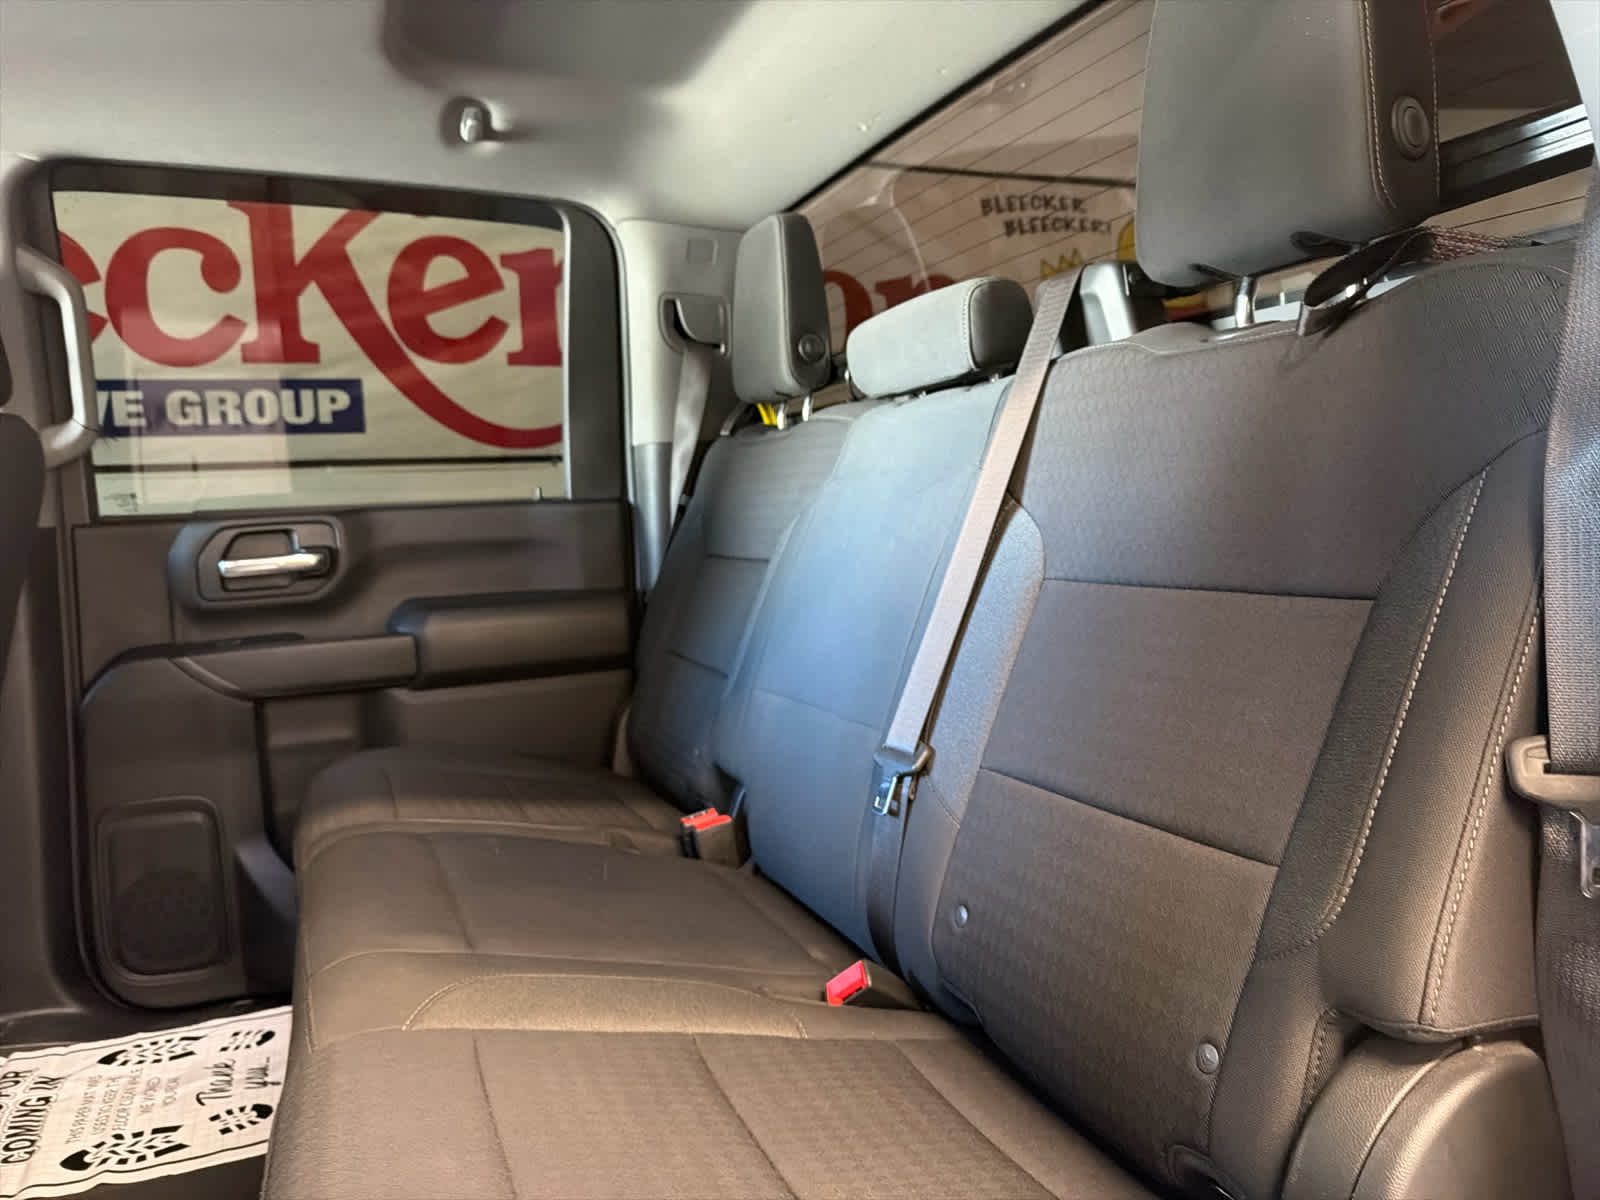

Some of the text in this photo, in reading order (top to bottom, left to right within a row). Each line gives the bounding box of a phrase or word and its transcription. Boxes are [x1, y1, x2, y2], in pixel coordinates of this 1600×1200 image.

[165, 388, 351, 427] GROUP
[1, 1075, 66, 1164] COMING IN
